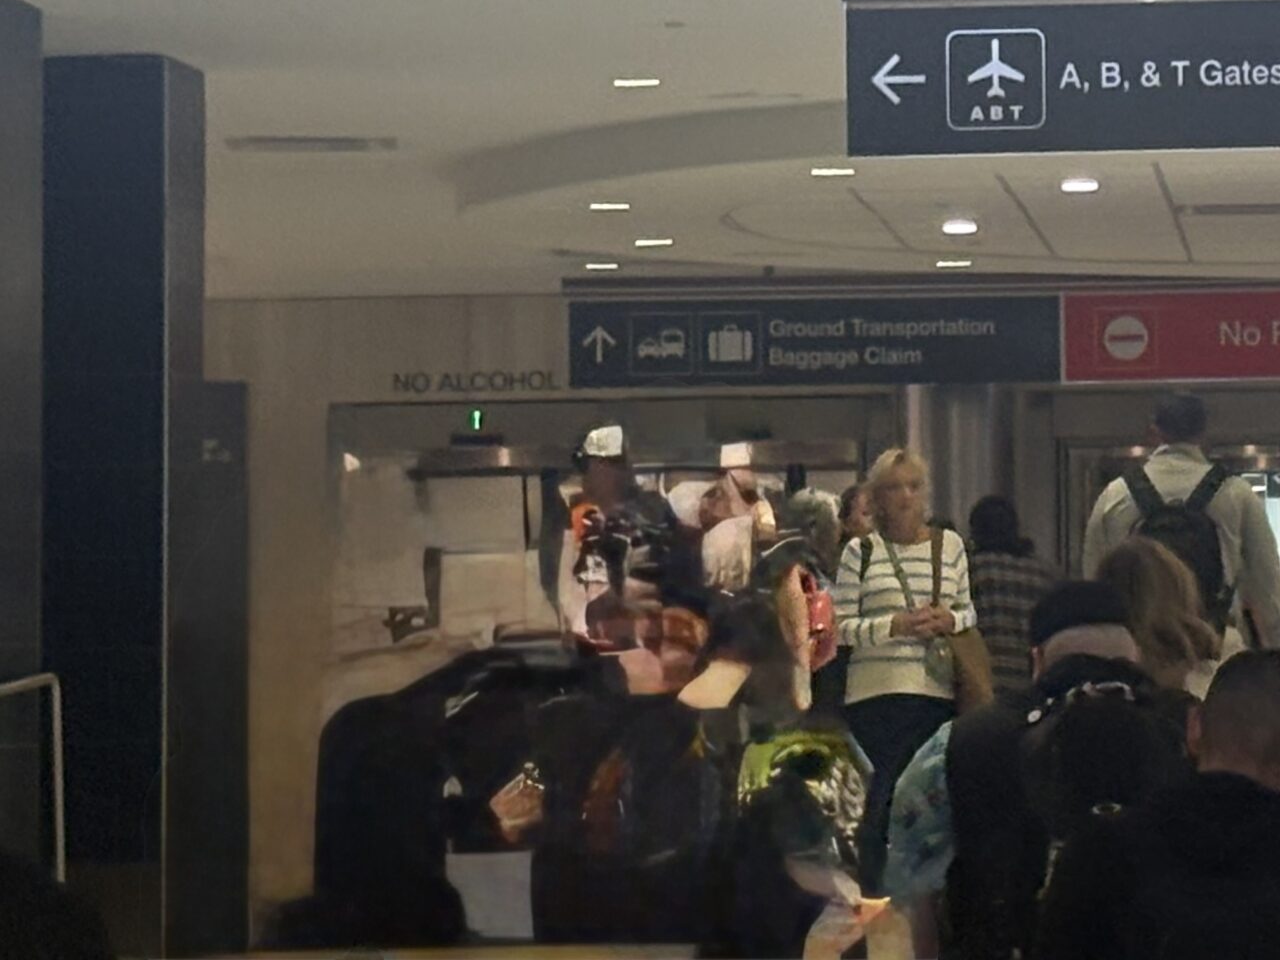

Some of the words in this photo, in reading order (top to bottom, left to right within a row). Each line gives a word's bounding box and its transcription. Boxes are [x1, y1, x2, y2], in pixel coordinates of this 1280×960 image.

[1059, 62, 1090, 93] A,
[1100, 61, 1130, 92] B,
[1140, 60, 1161, 88] &
[1171, 60, 1191, 87] T
[769, 318, 845, 339] Ground
[851, 317, 996, 341] Transportation
[1219, 319, 1262, 347] No
[769, 346, 859, 370] Baggage
[864, 345, 923, 366] Claim
[393, 372, 430, 394] NO
[437, 370, 563, 394] ALCOHOL
